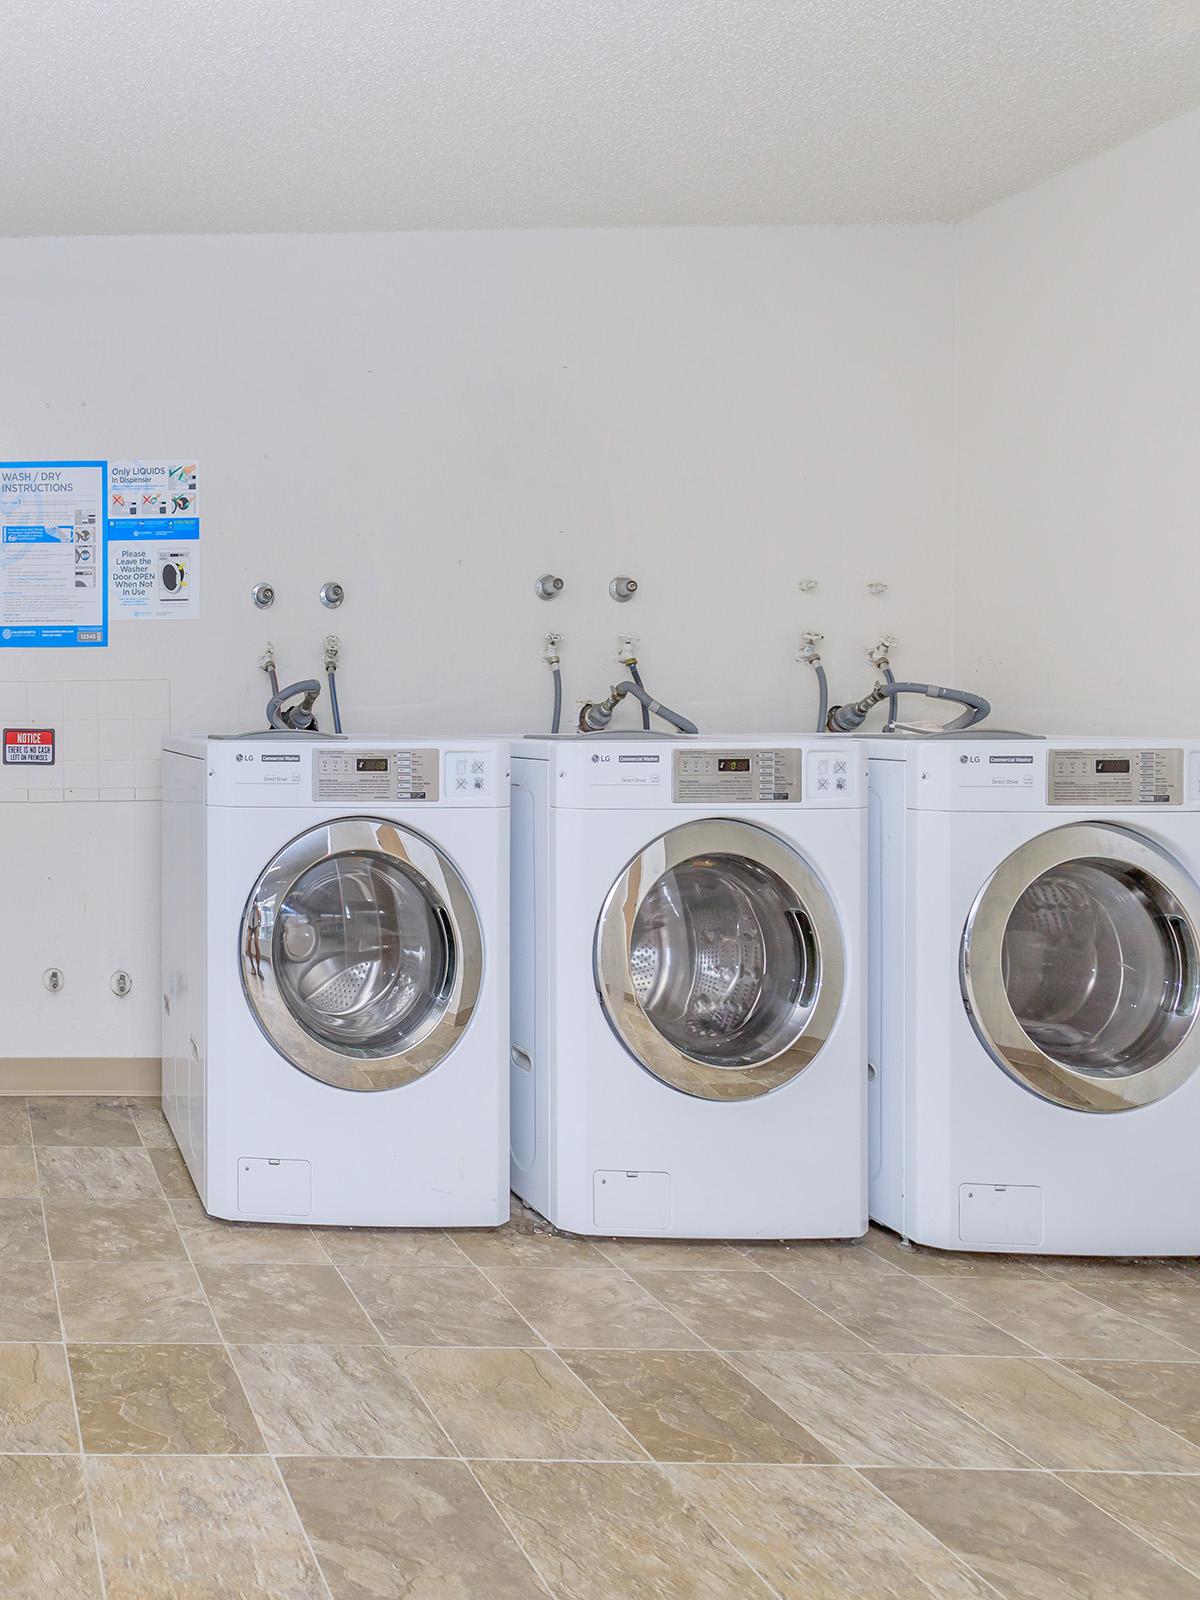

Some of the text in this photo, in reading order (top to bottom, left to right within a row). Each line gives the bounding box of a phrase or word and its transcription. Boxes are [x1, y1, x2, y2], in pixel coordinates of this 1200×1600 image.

[2, 473, 31, 481] WASH
[41, 472, 62, 480] DRY
[112, 468, 130, 476] Only
[2, 483, 73, 492] INSTRUCTIONS
[17, 733, 42, 744] NOTICE
